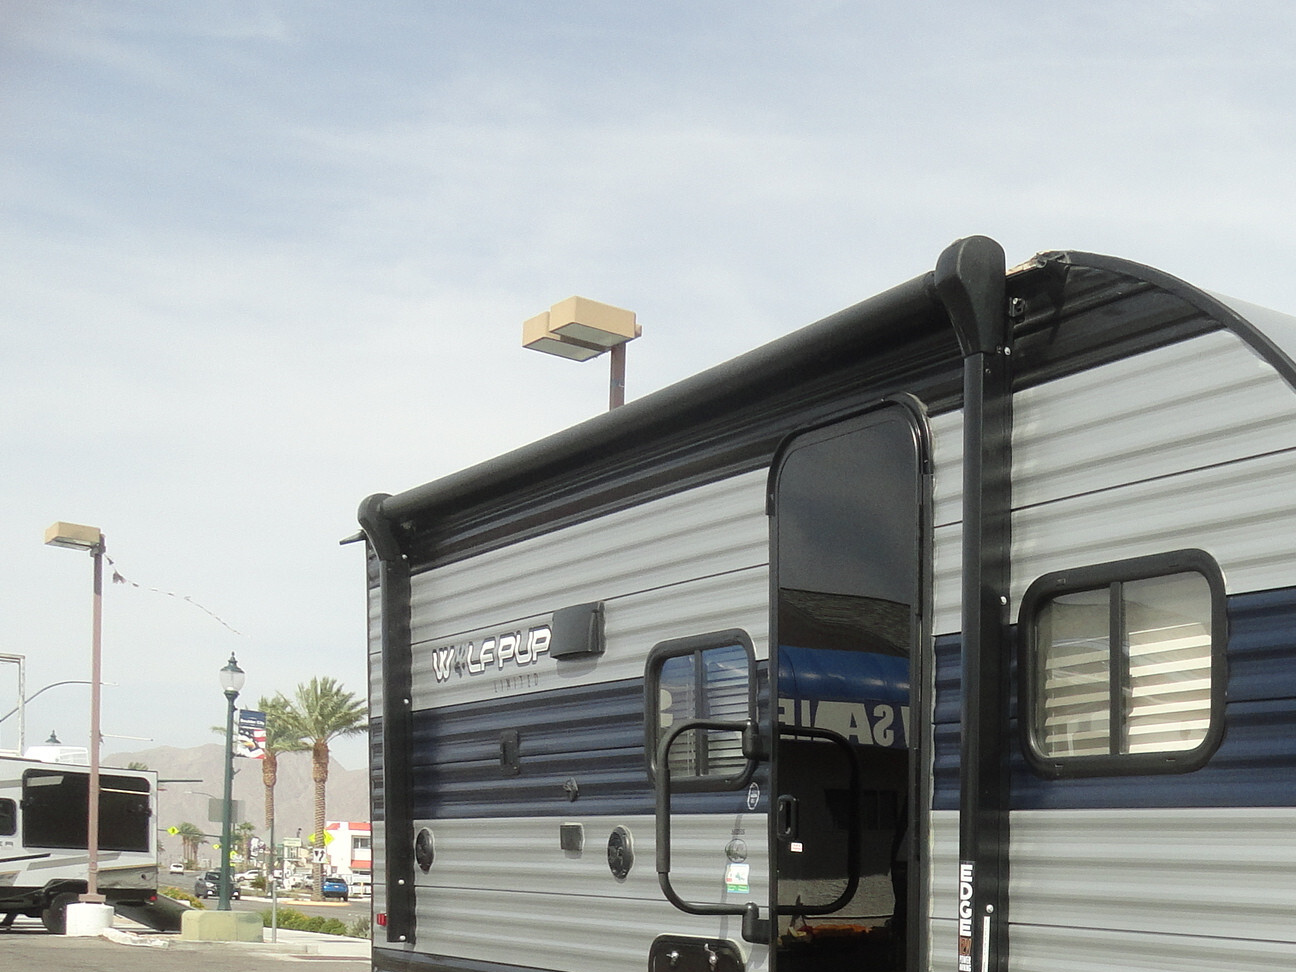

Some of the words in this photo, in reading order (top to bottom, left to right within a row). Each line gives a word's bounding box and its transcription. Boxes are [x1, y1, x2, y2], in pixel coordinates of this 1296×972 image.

[497, 624, 552, 670] PUP
[493, 673, 539, 693] LIMITED
[959, 864, 973, 937] EDGE
